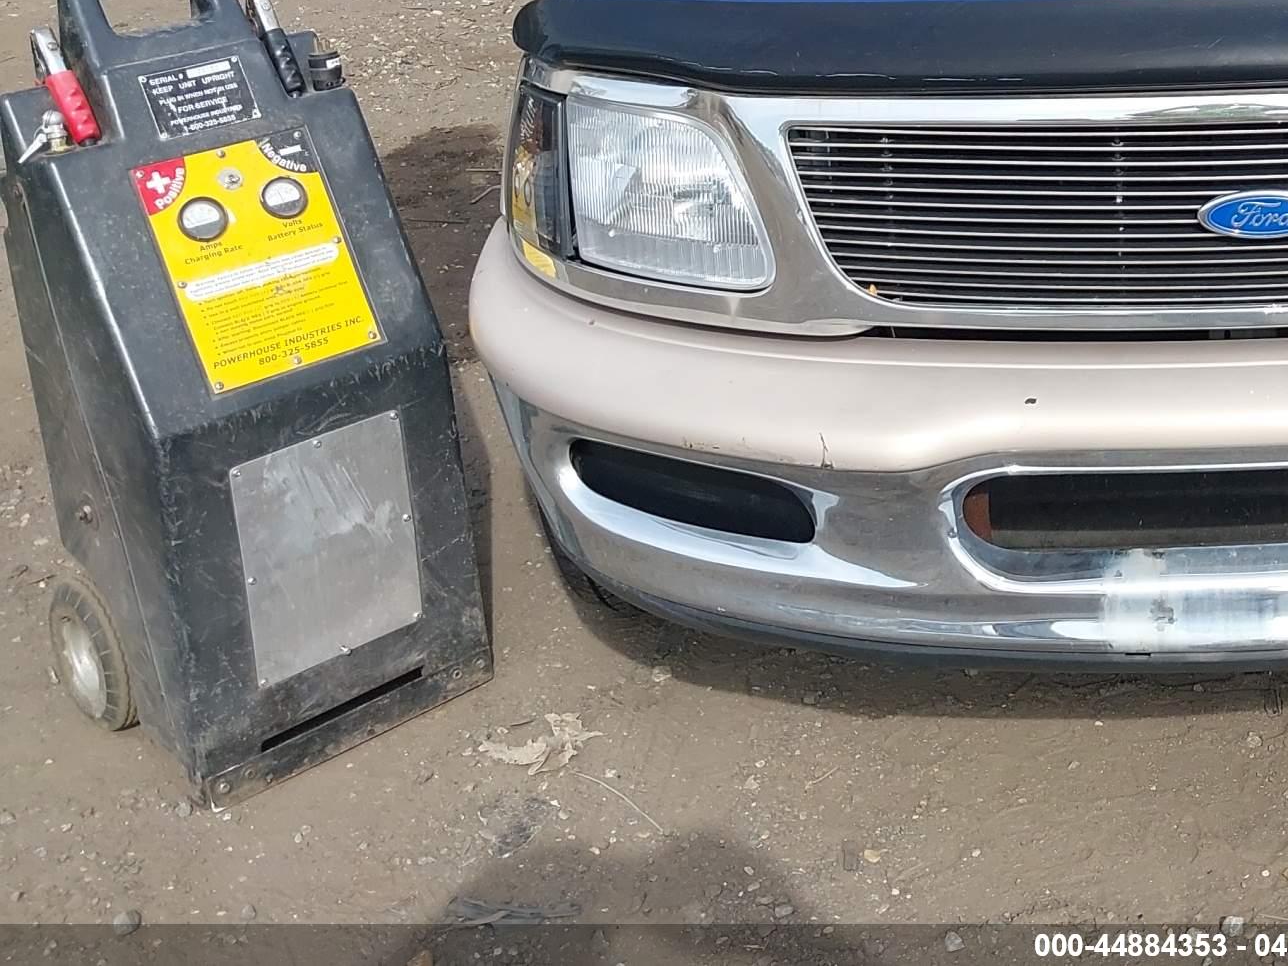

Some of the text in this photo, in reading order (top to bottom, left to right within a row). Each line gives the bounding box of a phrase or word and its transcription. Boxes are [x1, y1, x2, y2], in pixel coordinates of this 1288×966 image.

[149, 74, 178, 86] SERIAL
[152, 70, 235, 95] KEEP UNIT UPRIGHT
[159, 96, 177, 106] PLUG
[184, 90, 204, 100] WHEN
[177, 96, 229, 114] FOR SERVICE
[170, 112, 210, 126] POWERHOUSE
[261, 141, 308, 172] Negative
[155, 166, 186, 210] Positive
[267, 222, 324, 242] Battery Status
[281, 218, 303, 229] Volts
[184, 244, 244, 266] Charging Rate
[199, 241, 223, 253] Amps
[213, 341, 282, 370] POWERHOUSE
[284, 323, 343, 348] INDUSTRIES
[258, 336, 330, 366] 800-325-5855
